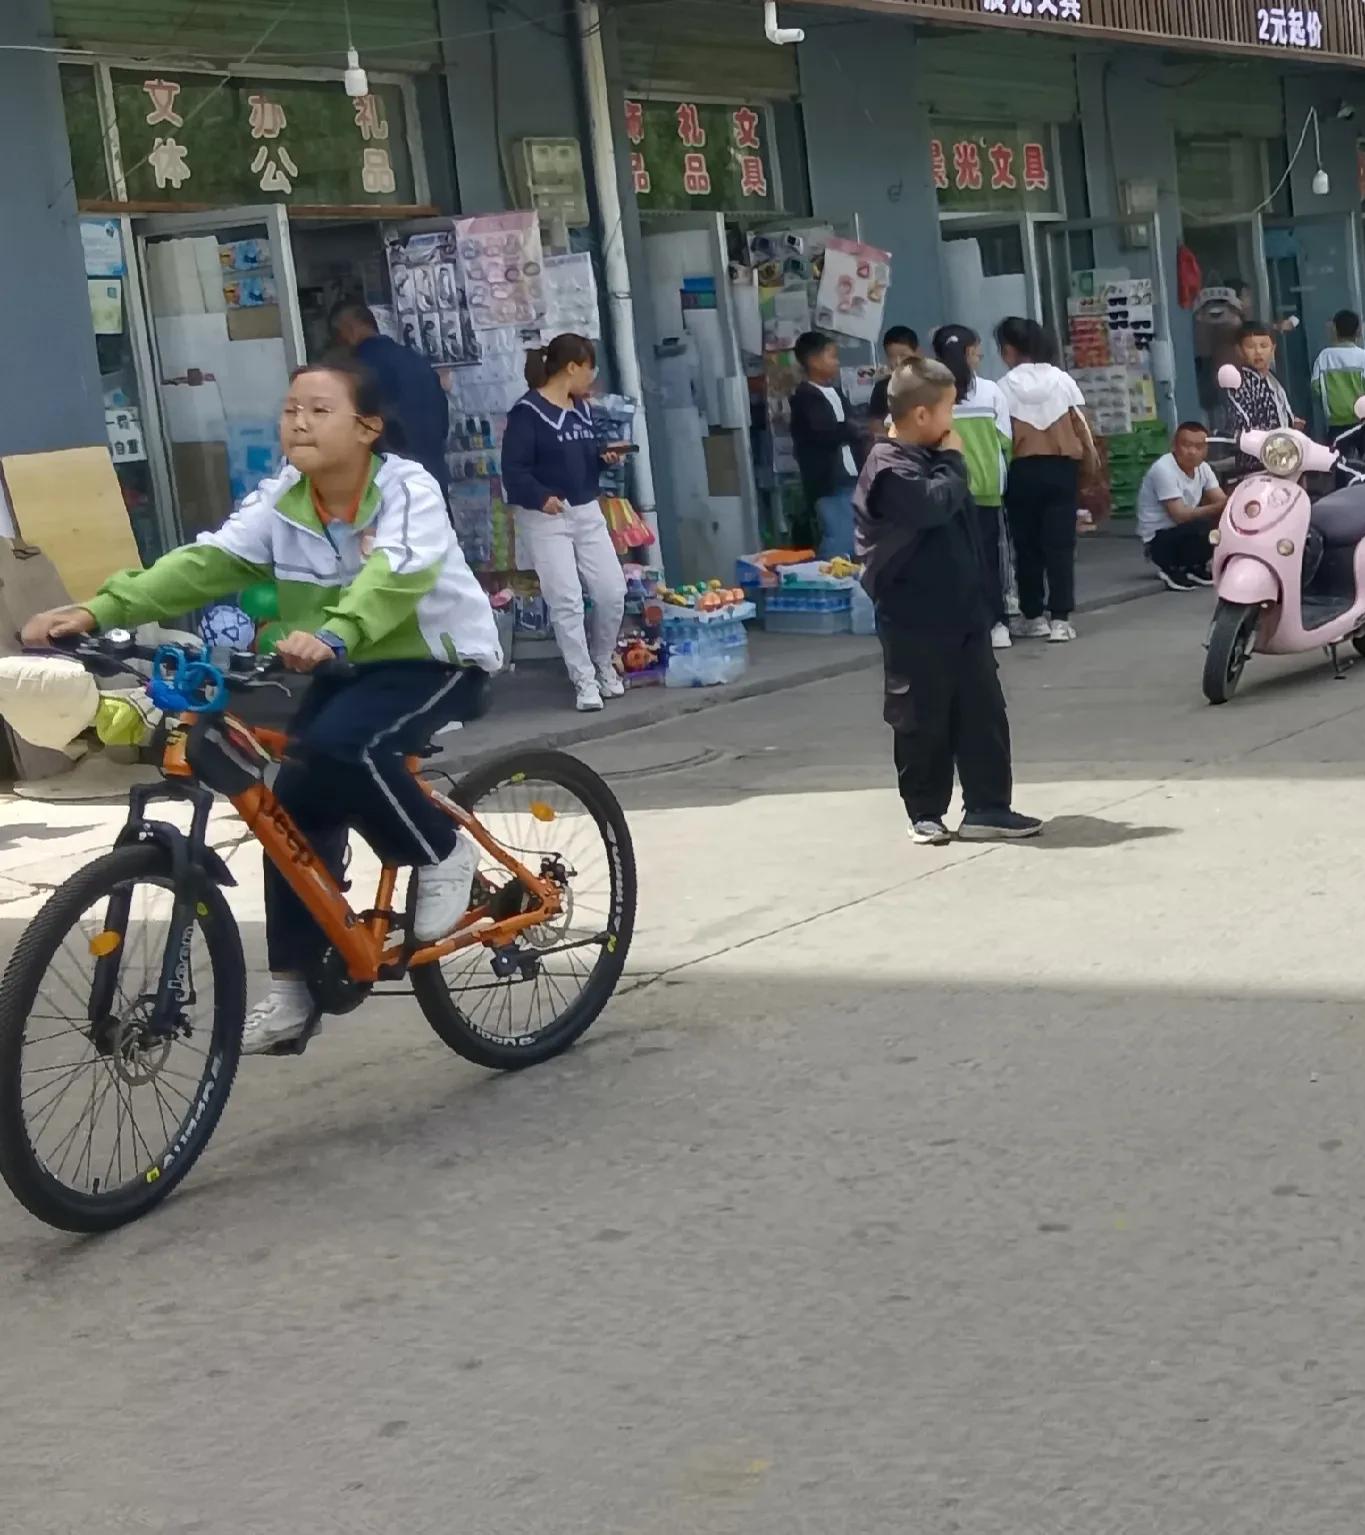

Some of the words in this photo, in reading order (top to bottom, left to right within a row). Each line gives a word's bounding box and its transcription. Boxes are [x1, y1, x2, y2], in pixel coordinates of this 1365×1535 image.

[1257, 8, 1322, 48] 2元起价
[143, 78, 191, 189] 文体
[248, 95, 299, 194] 办公
[352, 94, 396, 193] 礼品
[676, 103, 711, 195] 礼品
[733, 107, 766, 197] 文具
